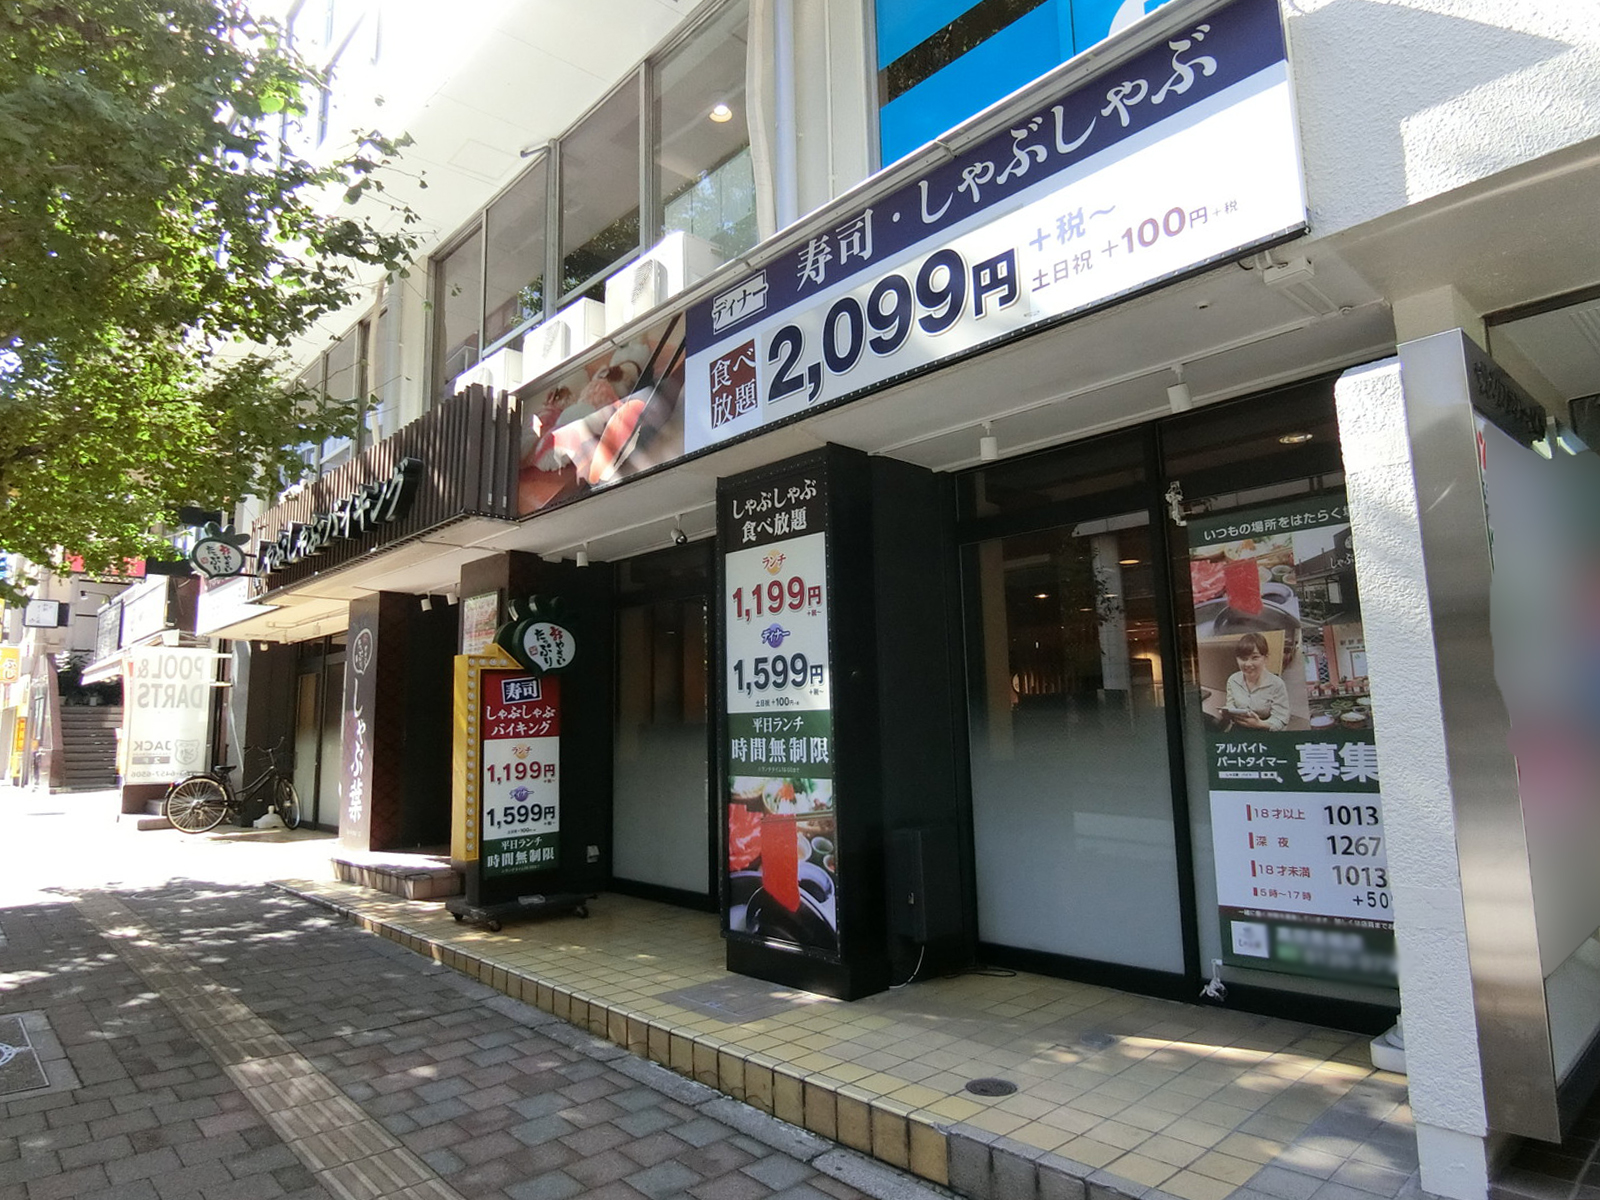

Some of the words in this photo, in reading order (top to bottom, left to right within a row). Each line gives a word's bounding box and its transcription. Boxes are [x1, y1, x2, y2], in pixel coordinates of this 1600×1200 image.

[796, 24, 1218, 292] 寿司・しゃぶしゃぶ
[1032, 250, 1093, 292] 土日祝
[713, 284, 769, 324] ディナー
[768, 247, 1018, 403] 2,099円
[712, 348, 757, 393] 食べ
[712, 379, 758, 428] 放題
[732, 479, 818, 519] しゃぶしゃぶ
[742, 506, 807, 543] 食べ放題
[761, 553, 787, 570] ランチ
[732, 576, 822, 621] 1,199円
[534, 628, 554, 667] たっぷり
[549, 626, 566, 666] おやさい
[761, 629, 791, 645] ディナー
[733, 653, 824, 695] 1,599円
[506, 680, 538, 700] 寿司
[486, 704, 556, 721] しゃぶしゃぶ
[752, 716, 804, 734] 平日ランチ
[491, 720, 552, 737] バイキング
[348, 678, 367, 824] しゃぶ葉
[511, 745, 533, 756] ランチ
[731, 736, 830, 764] 時間無制限
[1215, 743, 1268, 754] アルバイト
[486, 761, 556, 785] 1,199円
[1295, 742, 1379, 783] 募集
[486, 803, 556, 830] 1,599円
[1254, 808, 1306, 821] 18才以上
[1324, 805, 1379, 825] 1013
[501, 836, 543, 851] 平日ランチ
[1327, 835, 1381, 856] 1267
[487, 846, 555, 868] 時間無制限
[1259, 864, 1311, 878] 18才未満
[1332, 865, 1387, 888] 1013
